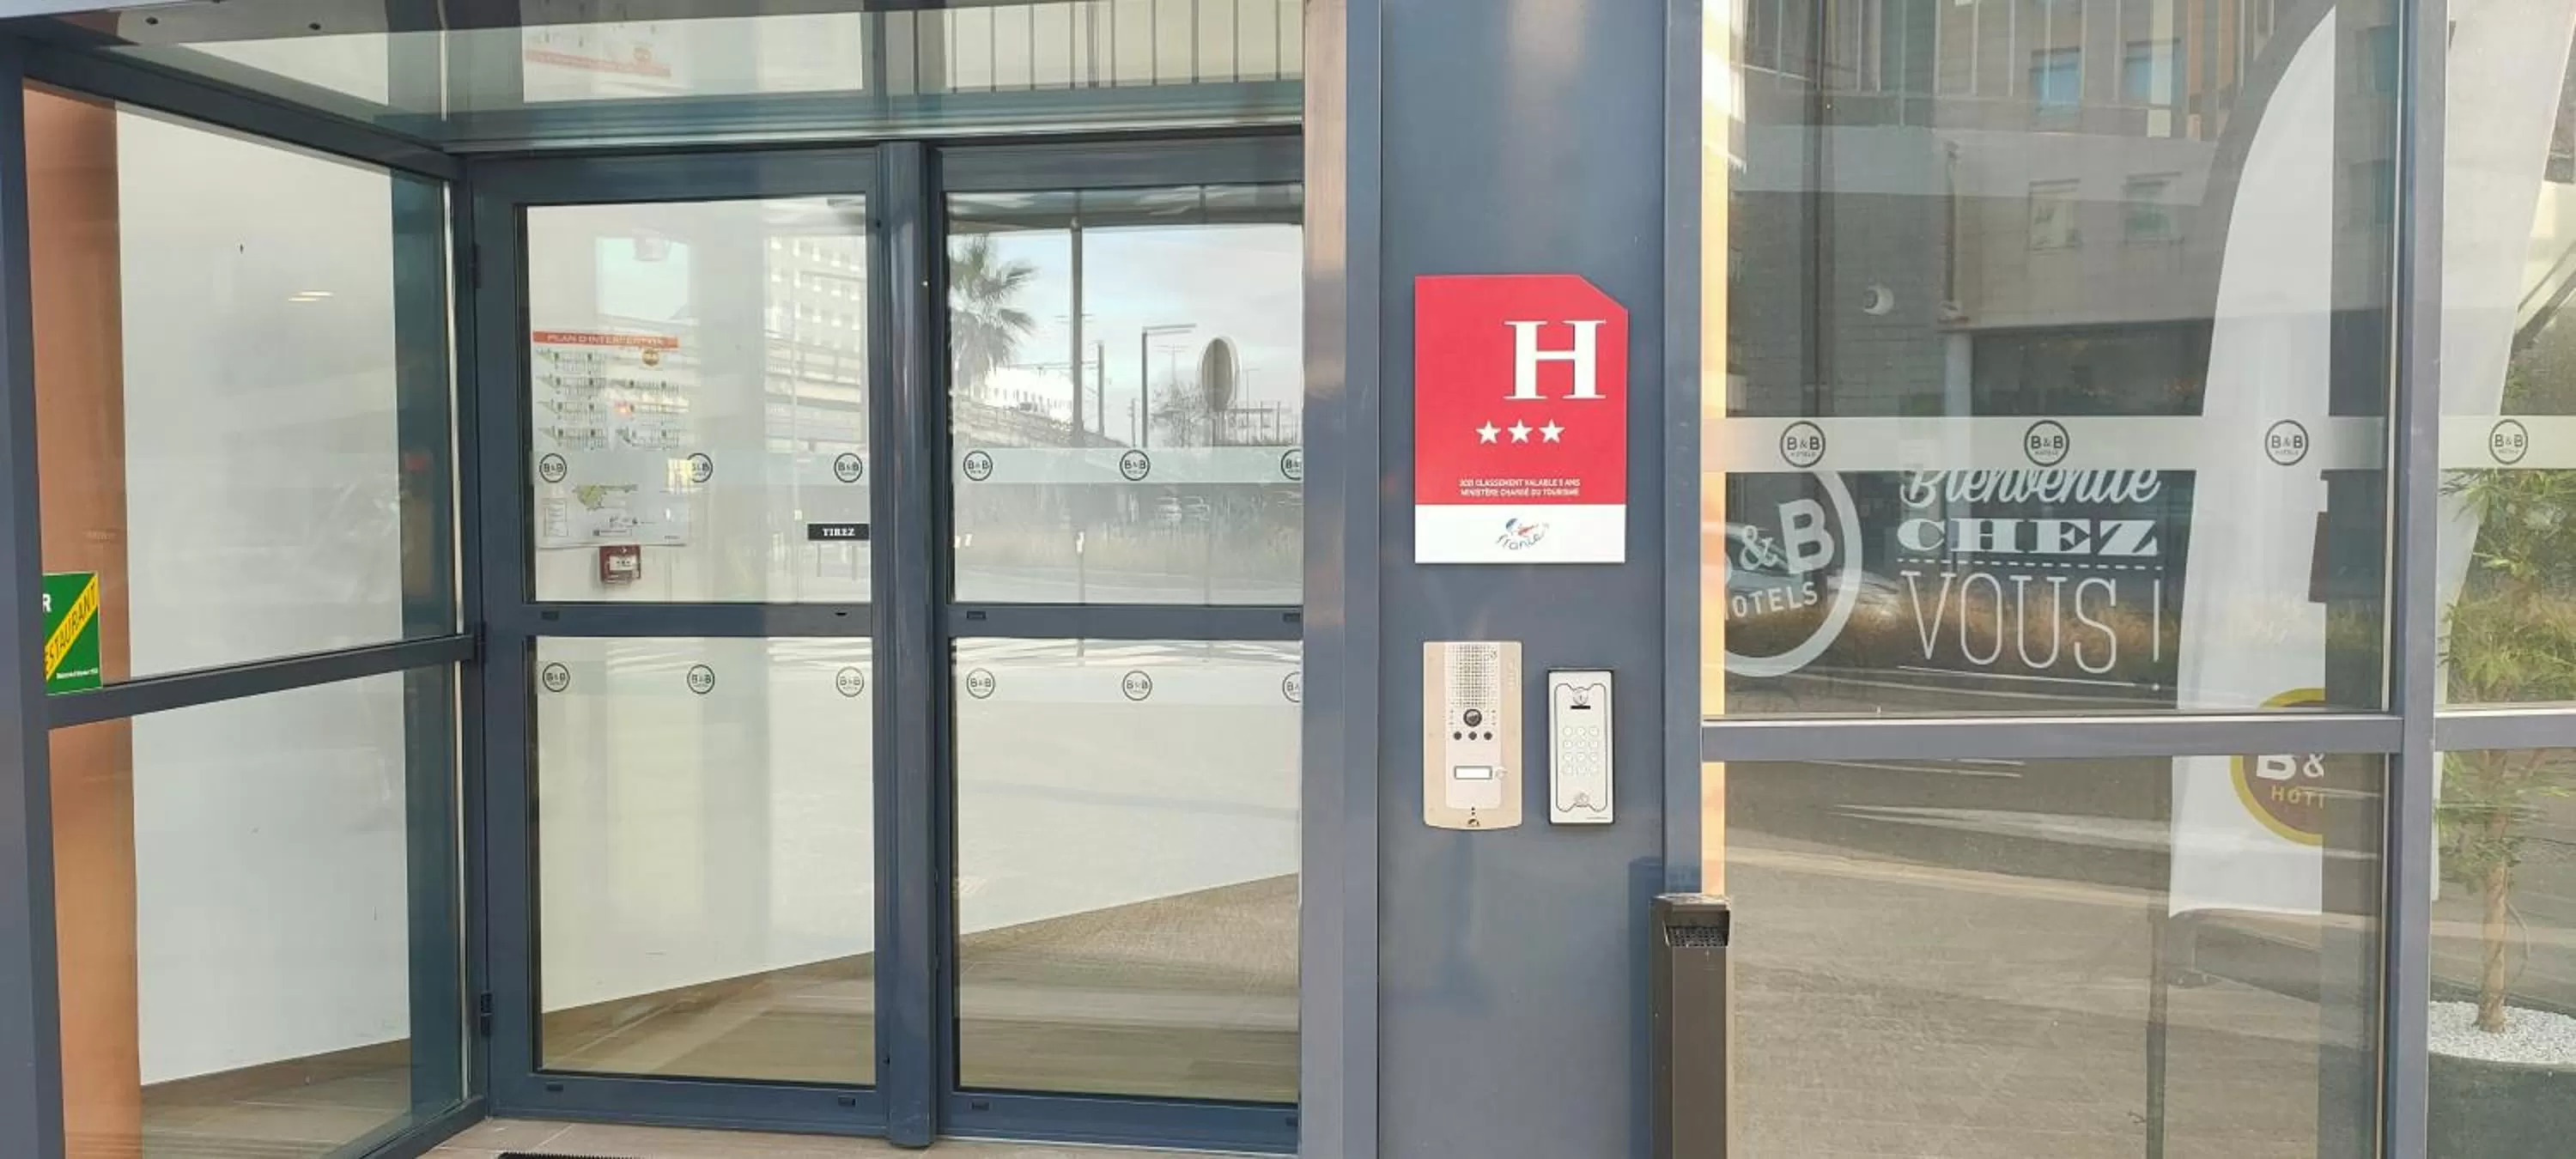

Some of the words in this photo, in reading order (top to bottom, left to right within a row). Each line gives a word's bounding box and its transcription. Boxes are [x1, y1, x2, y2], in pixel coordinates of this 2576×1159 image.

[1504, 320, 1607, 399] H
[823, 527, 856, 537] TIREZ
[1897, 518, 2158, 556] CHEZ
[1725, 580, 1818, 621] OTELS
[1899, 570, 2117, 674] VOUS
